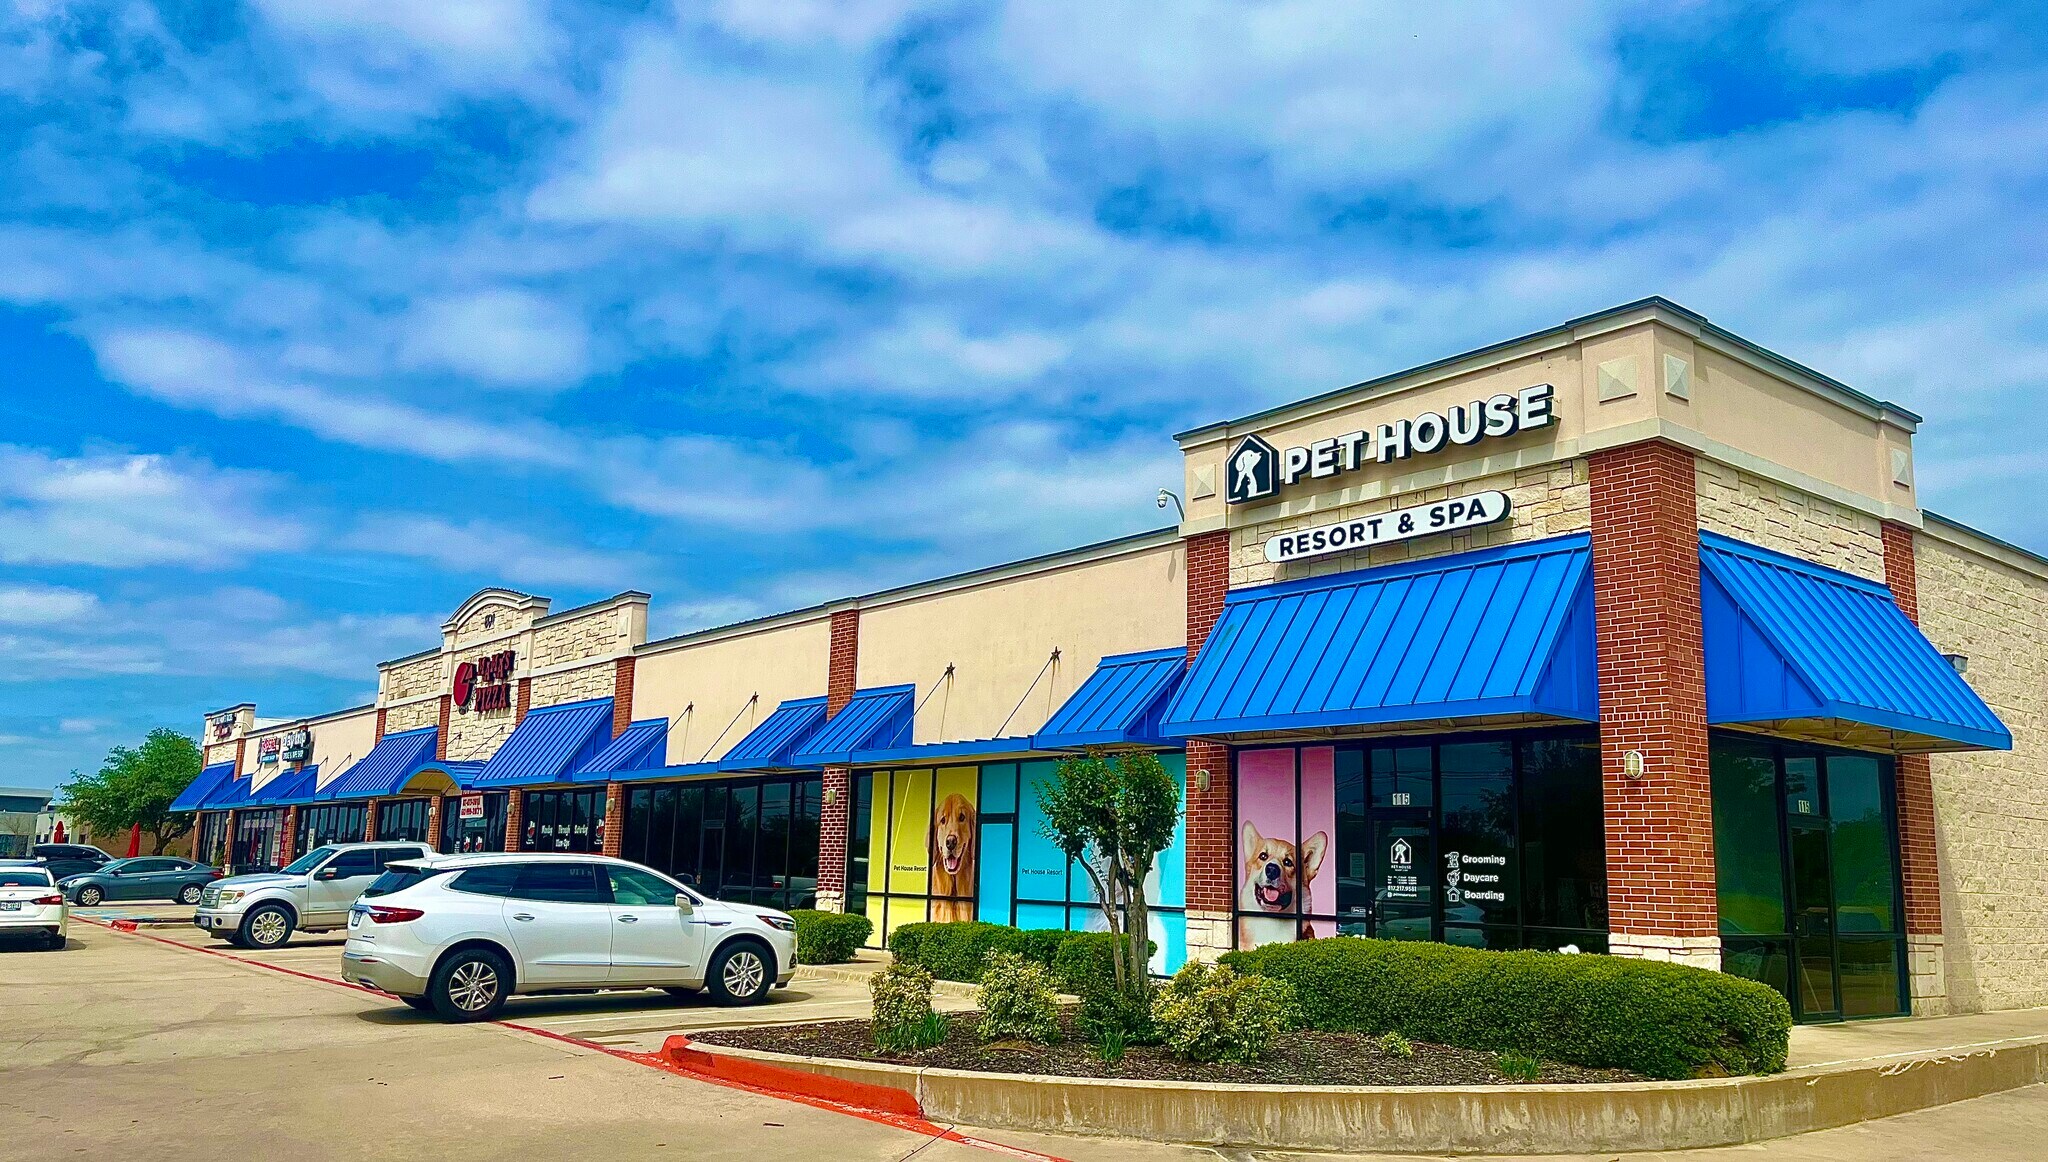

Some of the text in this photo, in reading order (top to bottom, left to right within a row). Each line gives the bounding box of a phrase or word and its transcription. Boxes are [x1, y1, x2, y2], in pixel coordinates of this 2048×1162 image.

[1284, 383, 1555, 485] PET HOUSE
[1279, 498, 1487, 557] RESORT & SPA
[475, 684, 508, 712] PIZZA
[1392, 793, 1410, 806] 115
[1798, 800, 1811, 814] 115
[1461, 854, 1506, 866] Grooming
[1463, 873, 1499, 884] Daycare
[1464, 890, 1505, 901] Boarding
